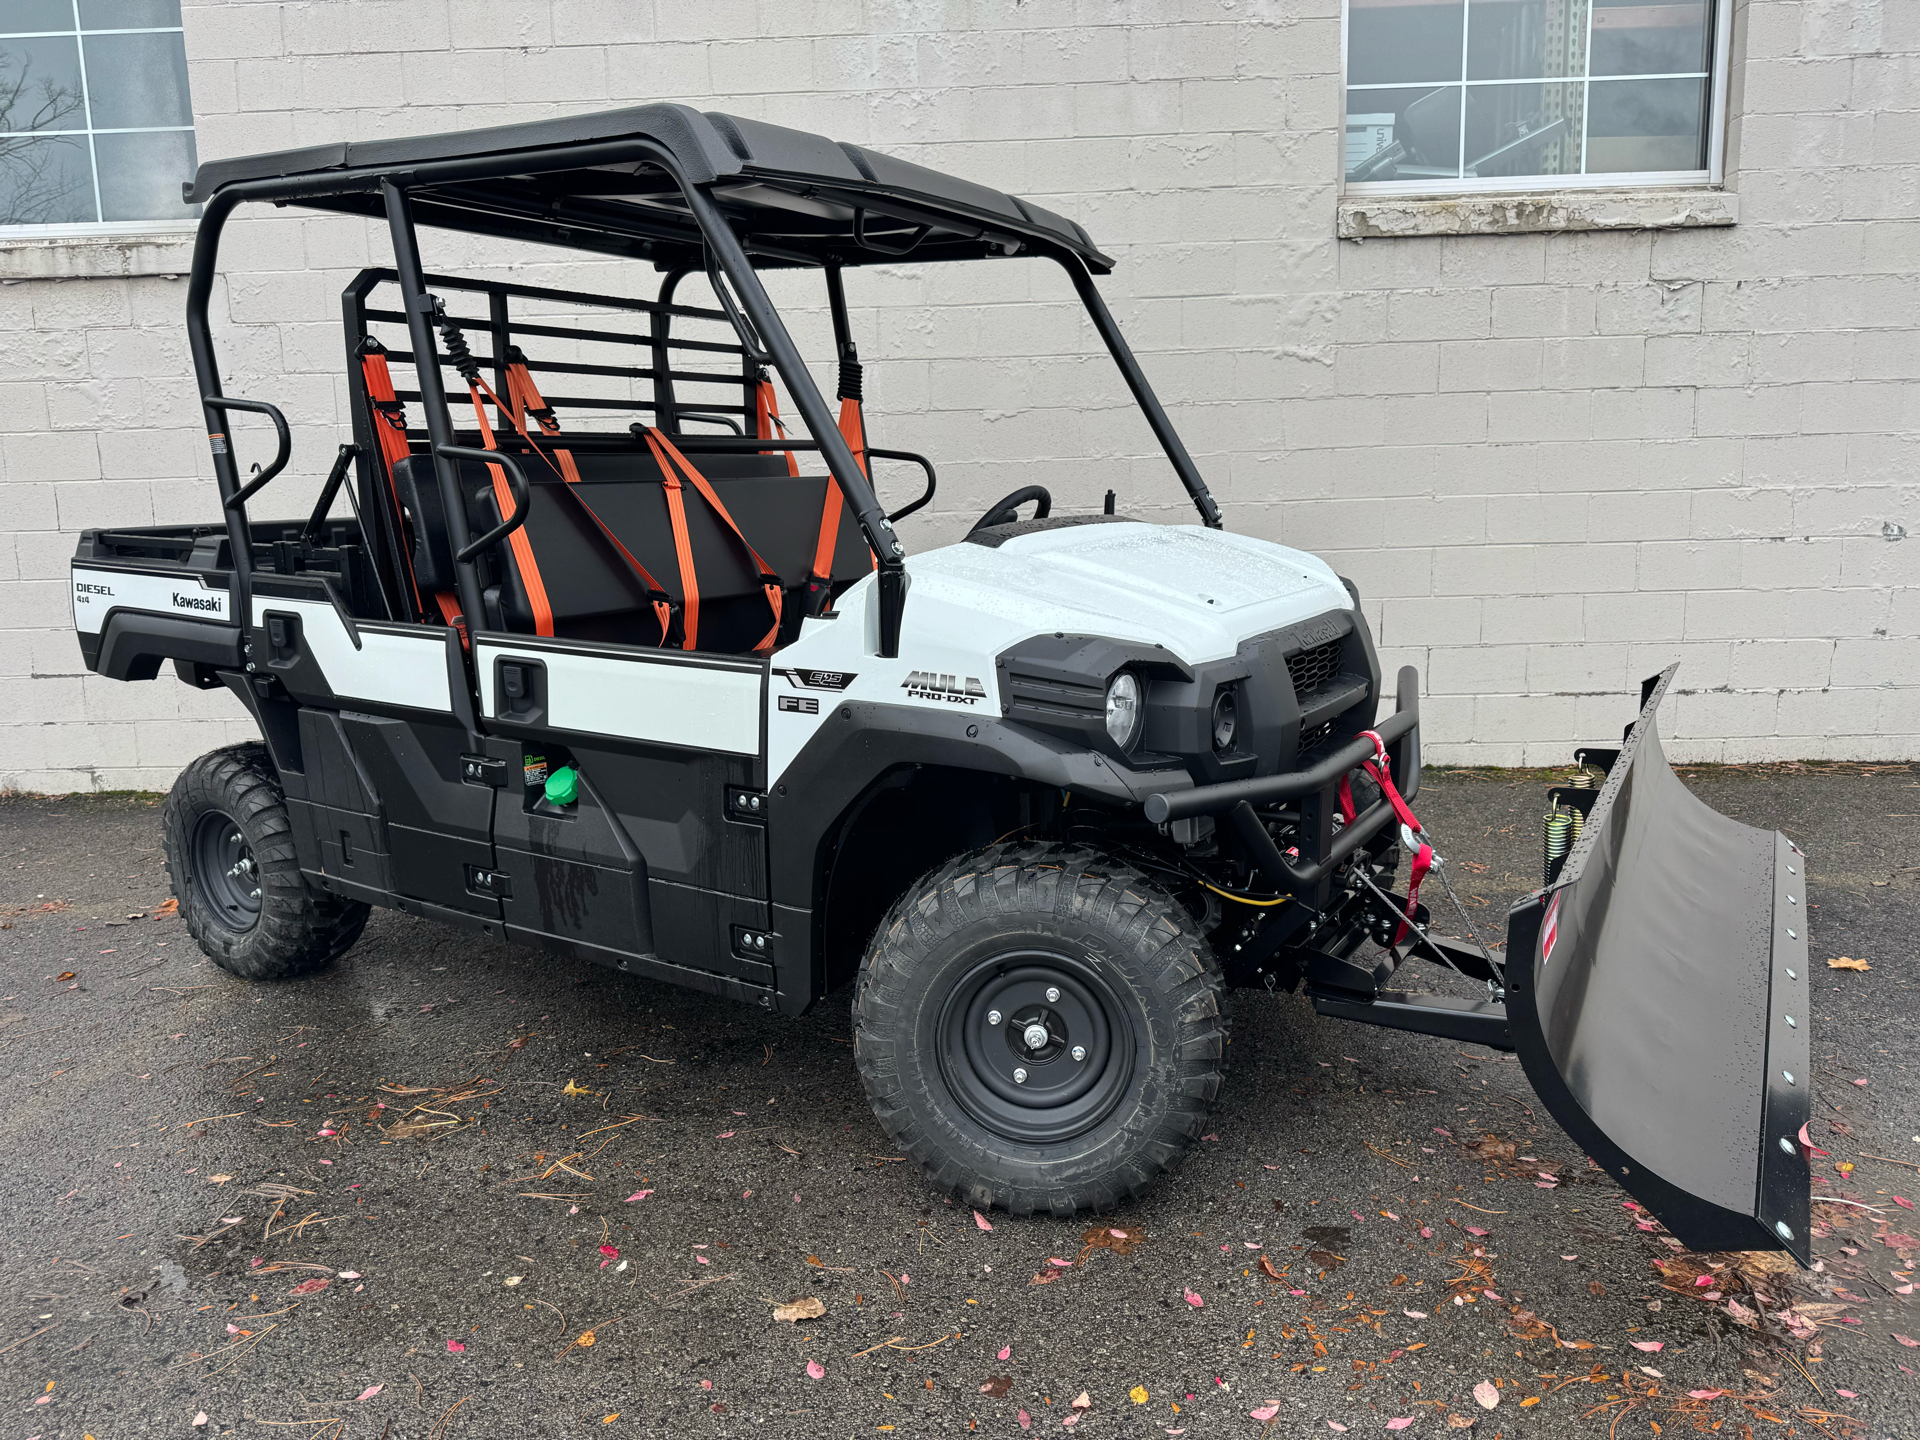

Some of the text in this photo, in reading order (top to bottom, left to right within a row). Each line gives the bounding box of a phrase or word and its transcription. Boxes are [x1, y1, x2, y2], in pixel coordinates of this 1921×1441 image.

[76, 583, 115, 596] DIESEL
[172, 592, 222, 612] Kawasaki
[1290, 618, 1341, 650] Kawasaki
[900, 670, 988, 699] MULE
[778, 696, 819, 713] FE
[907, 689, 979, 706] PRO-DXT
[1075, 932, 1171, 1047] DURO
